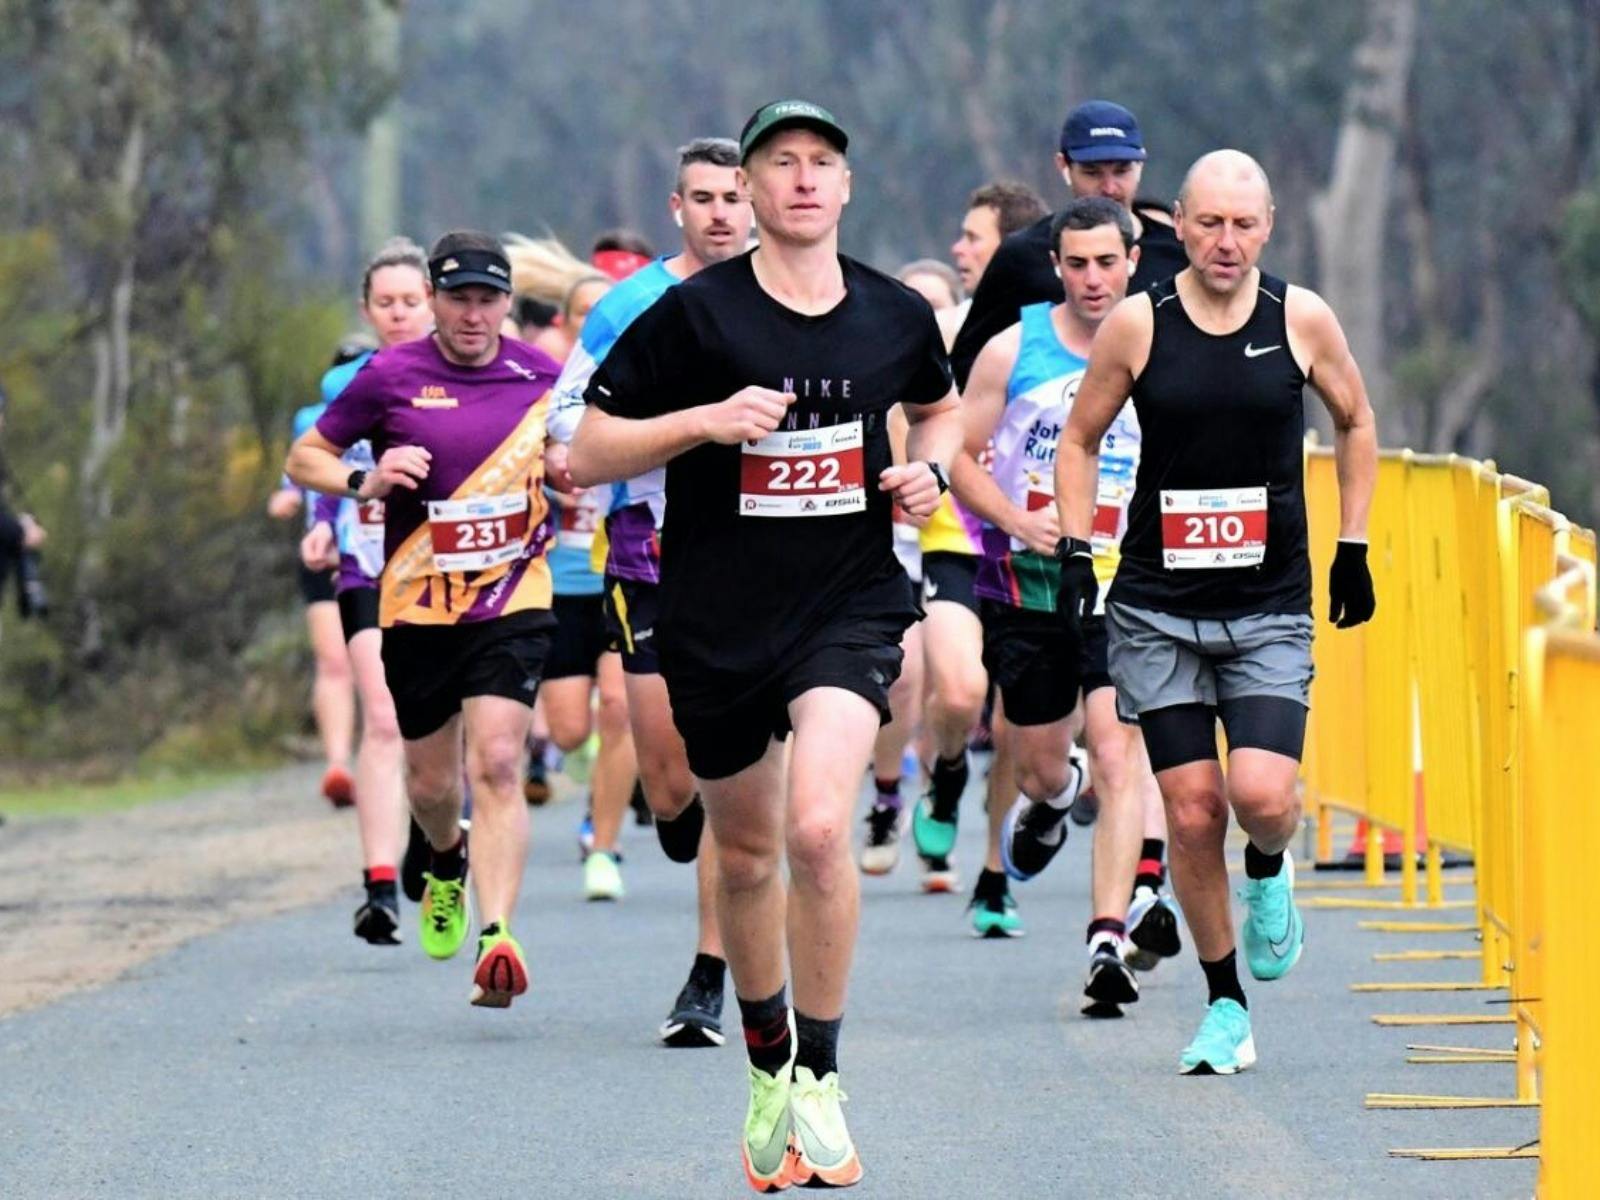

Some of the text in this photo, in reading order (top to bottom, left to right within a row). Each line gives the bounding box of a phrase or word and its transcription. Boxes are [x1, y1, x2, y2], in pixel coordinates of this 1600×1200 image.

[783, 377, 851, 398] NIKE
[767, 457, 841, 490] 222
[455, 519, 507, 550] 231
[1184, 515, 1245, 544] 210
